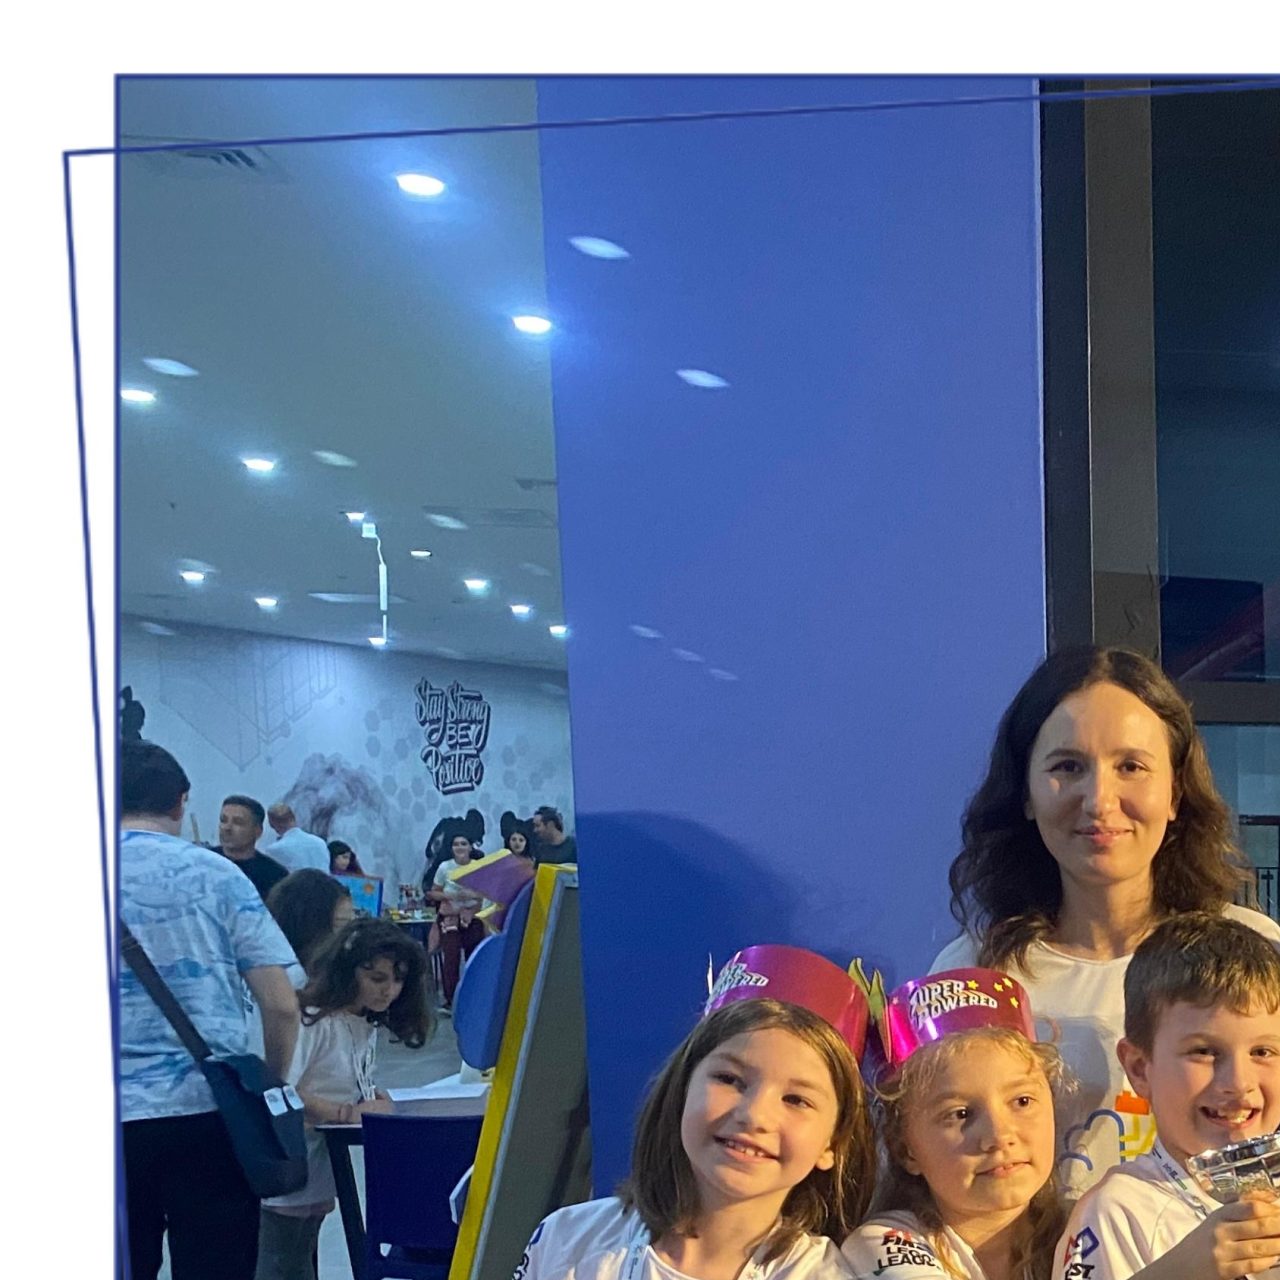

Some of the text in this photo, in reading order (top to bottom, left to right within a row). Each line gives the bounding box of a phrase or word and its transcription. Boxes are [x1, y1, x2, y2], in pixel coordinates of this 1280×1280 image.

[414, 677, 491, 752] Stay Strong
[446, 722, 472, 748] BE
[917, 990, 998, 1029] POWERED
